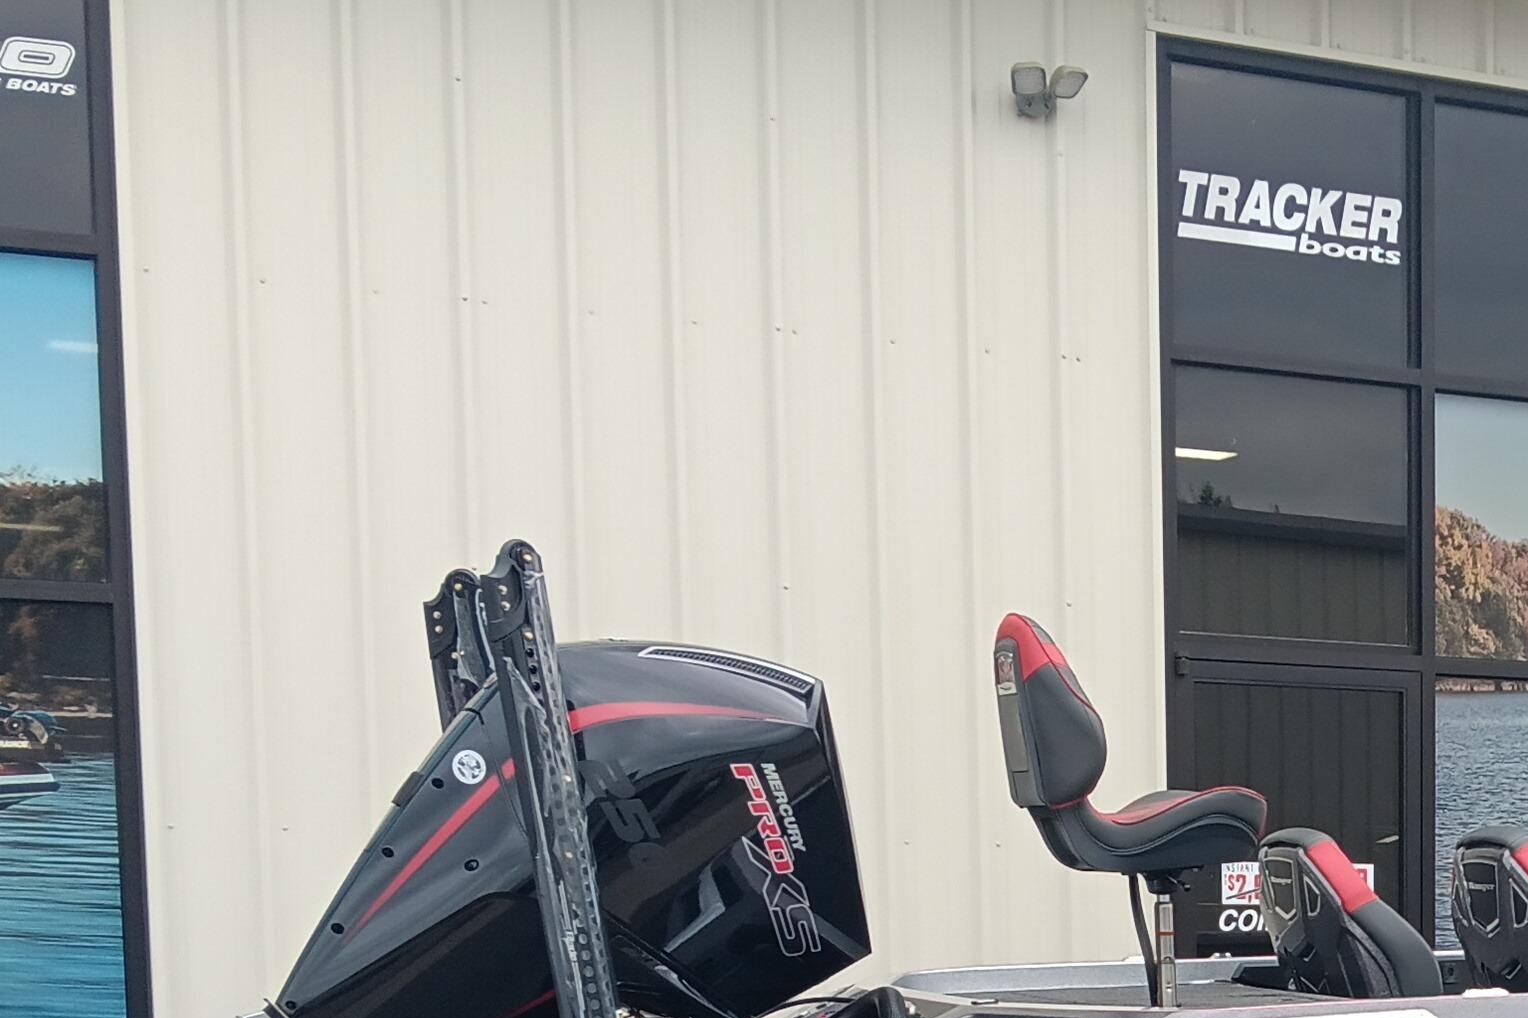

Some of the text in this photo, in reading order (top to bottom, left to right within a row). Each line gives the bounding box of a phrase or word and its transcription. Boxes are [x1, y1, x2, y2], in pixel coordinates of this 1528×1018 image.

[5, 78, 76, 96] BOATS
[1178, 169, 1403, 244] TRACKER
[1298, 232, 1401, 265] boats
[760, 762, 807, 852] MERCURY
[729, 763, 822, 957] PRO XS
